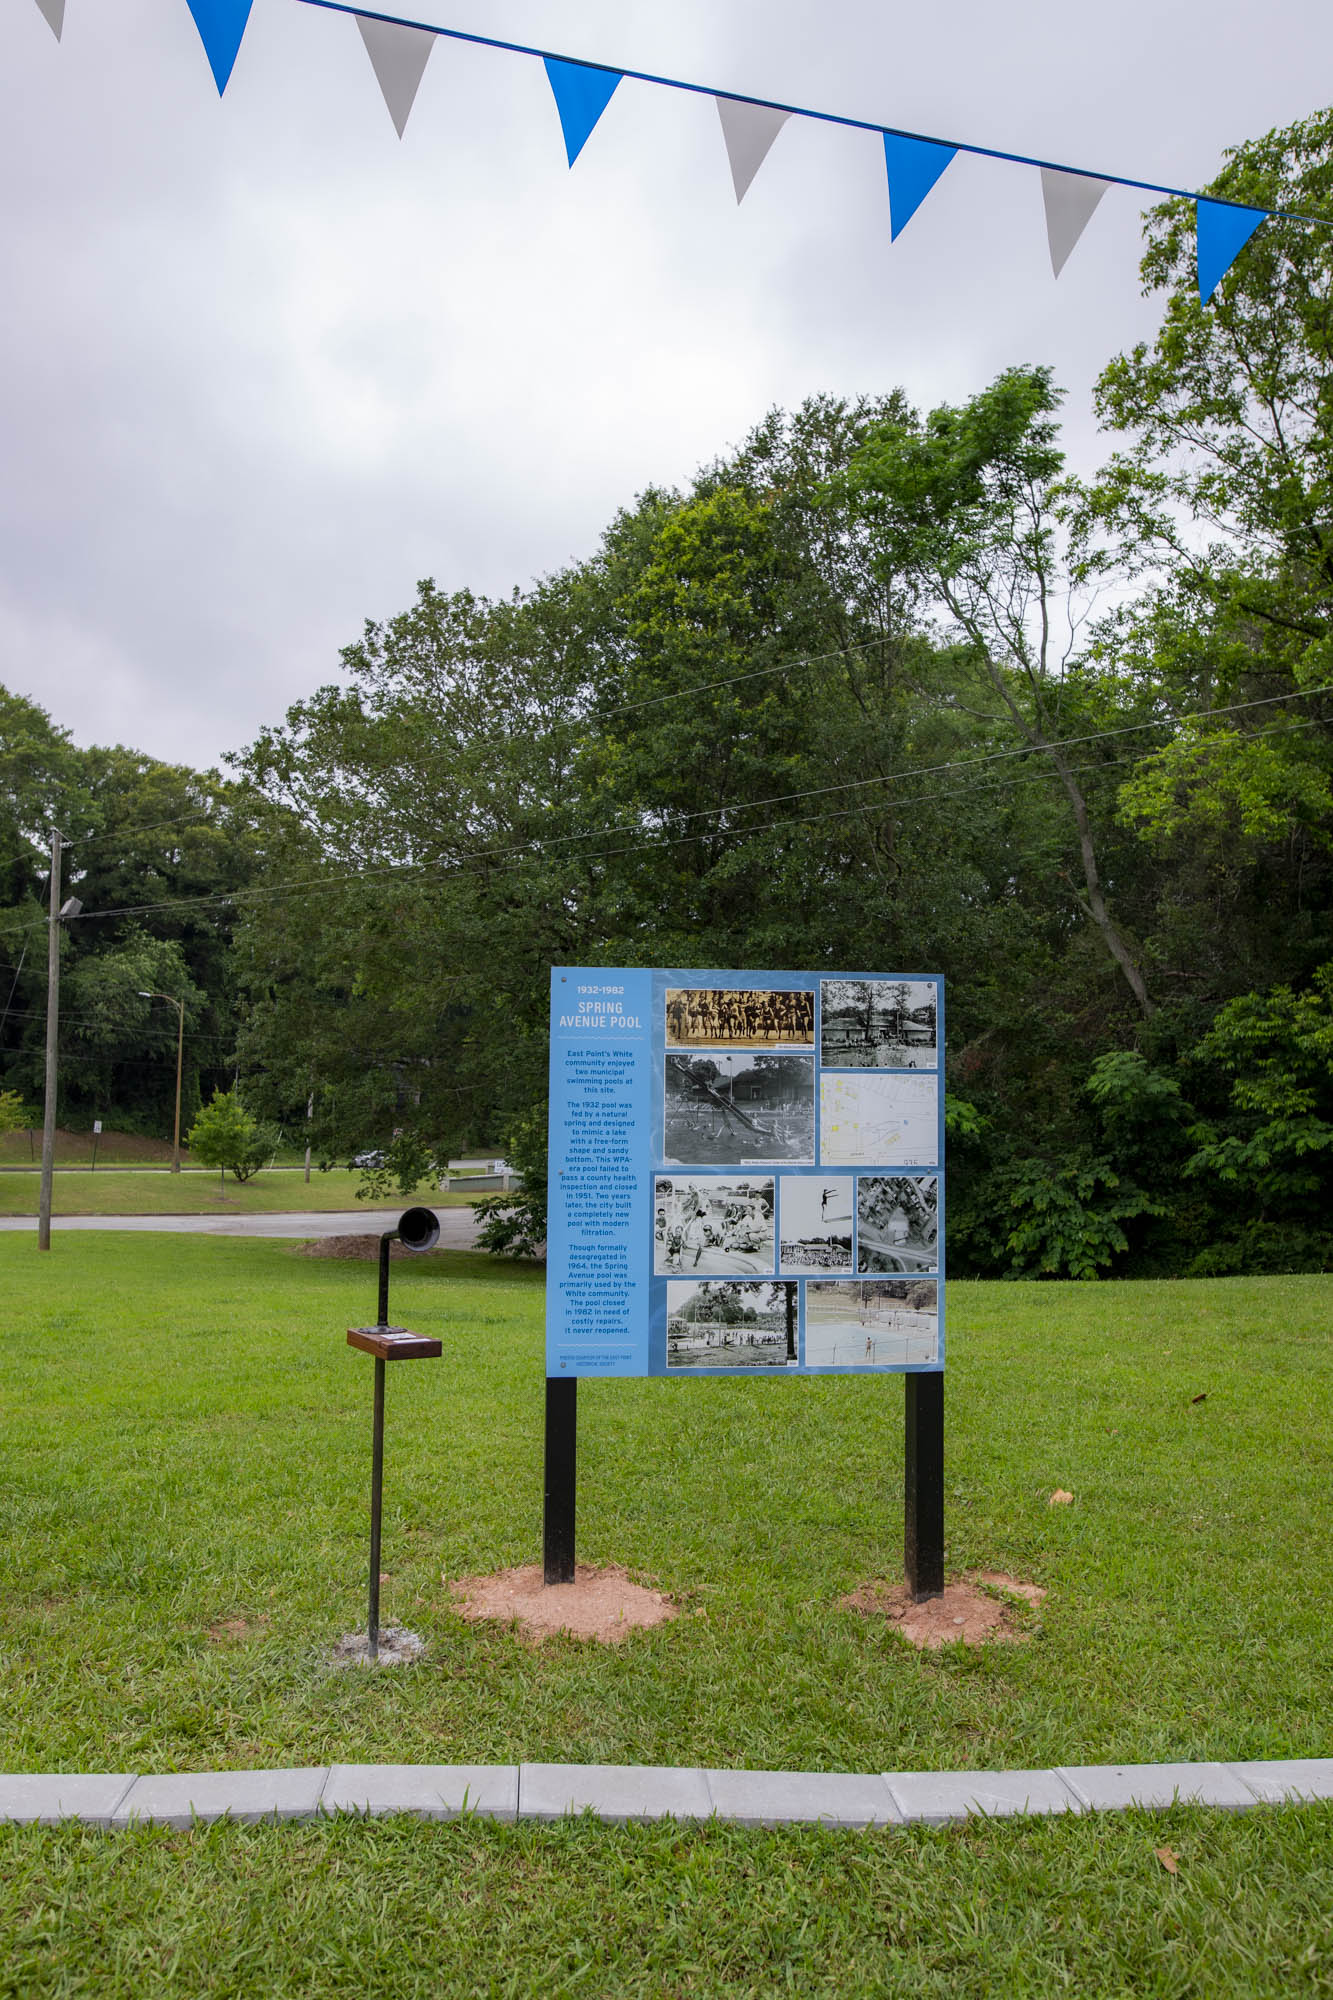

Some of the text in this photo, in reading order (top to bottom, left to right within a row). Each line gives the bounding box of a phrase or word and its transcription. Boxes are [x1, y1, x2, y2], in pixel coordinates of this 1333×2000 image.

[577, 985, 625, 995] 1932-1982
[578, 1001, 623, 1015] SPRING
[559, 1015, 642, 1028] AVENUE POOL
[590, 1068, 624, 1076] municipal
[566, 1077, 602, 1086] swimming
[602, 1101, 616, 1110] pool
[572, 1109, 582, 1118] fed
[564, 1119, 586, 1128] spring
[602, 1119, 636, 1128] designed
[608, 1146, 628, 1154] sandy
[586, 1174, 612, 1182] county
[614, 1173, 636, 1182] health
[600, 1201, 614, 1210] city
[574, 1210, 614, 1218] completely
[580, 1228, 616, 1236] filtration.
[568, 1244, 628, 1252] Though formally
[570, 1253, 618, 1262] desegregated
[604, 1262, 628, 1270] Spring
[596, 1271, 612, 1280] pool
[588, 1289, 630, 1298] community.
[602, 1298, 626, 1306] closed
[572, 1317, 594, 1326] costly
